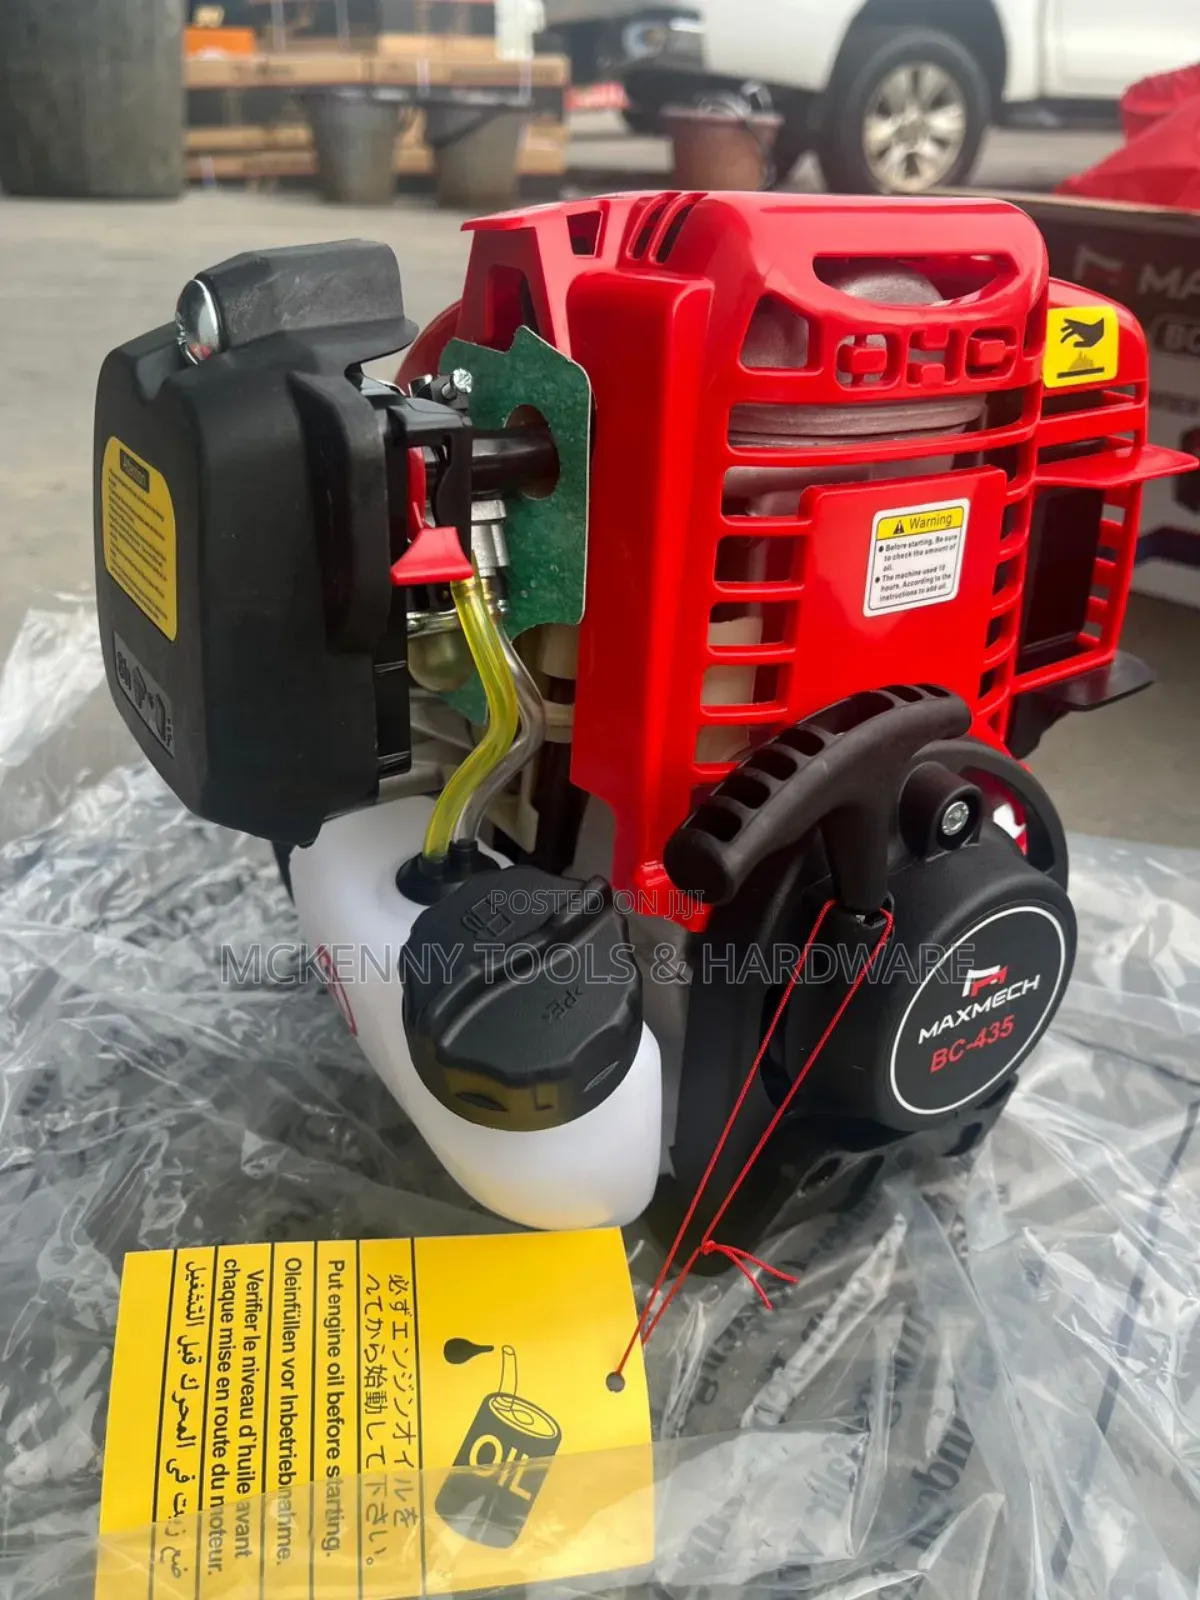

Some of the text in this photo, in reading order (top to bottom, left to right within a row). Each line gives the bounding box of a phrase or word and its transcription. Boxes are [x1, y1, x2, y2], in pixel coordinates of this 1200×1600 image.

[886, 543, 907, 552] Before
[909, 514, 953, 530] Warning
[882, 574, 894, 582] The
[895, 568, 921, 579] machine
[923, 566, 937, 575] used
[884, 554, 891, 562] to
[892, 551, 912, 560] check
[913, 548, 923, 556] the
[925, 545, 948, 555] amount
[903, 577, 934, 588] According
[879, 589, 917, 602] instructions
[918, 974, 1040, 1045] MAXMECH
[930, 1014, 1016, 1073] BC-435
[185, 1260, 207, 1327] التشغيل
[244, 1269, 264, 1332] Verifier
[177, 1334, 202, 1365] قبل
[243, 1336, 261, 1352] le
[171, 1373, 200, 1449] المحرك
[208, 1258, 241, 1576] chaque mise en route du moteur.
[239, 1355, 260, 1420] niveau
[276, 1257, 302, 1566] Oleinfüllen vor Inbetriebnahme.
[321, 1260, 345, 1557] Put engine oil before starting.
[388, 1273, 418, 1528] 必ずエンジンオイルを
[469, 1434, 532, 1501] OIL
[165, 1492, 187, 1537] زيت
[234, 1500, 252, 1559] avant
[160, 1545, 188, 1580] ضع
